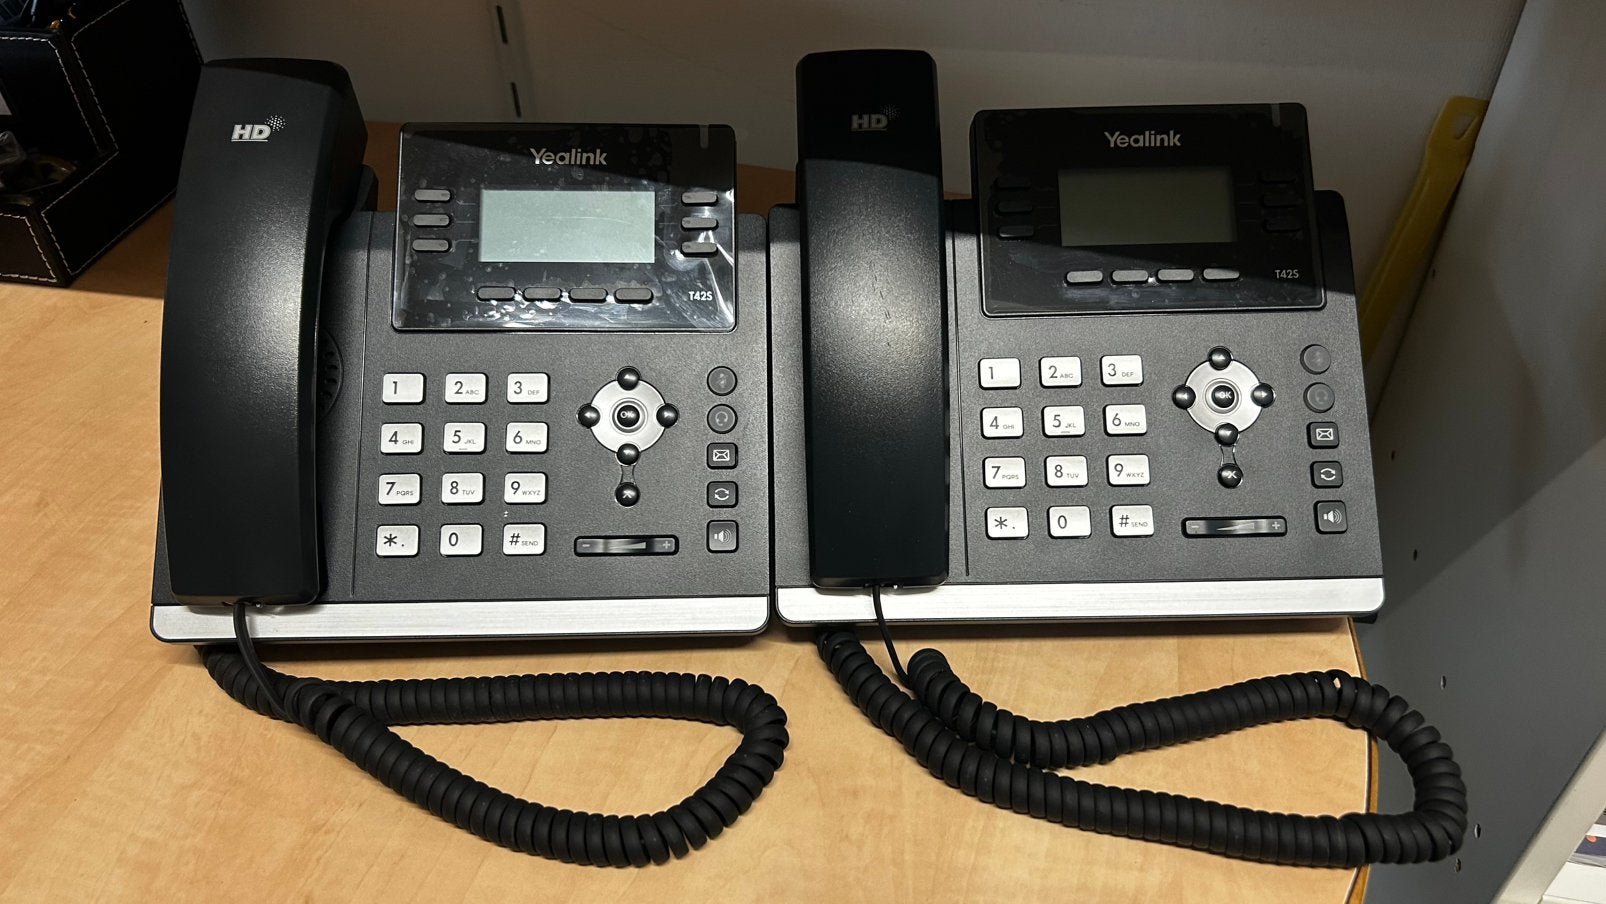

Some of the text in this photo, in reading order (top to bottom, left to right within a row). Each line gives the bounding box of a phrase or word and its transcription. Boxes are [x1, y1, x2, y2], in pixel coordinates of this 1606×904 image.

[851, 114, 888, 131] HD
[231, 124, 271, 142] HD
[1104, 130, 1182, 148] Yealink
[530, 148, 607, 166] Yealink
[1275, 269, 1299, 279] T42S
[688, 291, 712, 301] T42S
[988, 366, 994, 380] 1
[1048, 365, 1058, 378] 2
[1107, 363, 1117, 377] 3
[392, 380, 398, 395] 1
[454, 380, 464, 395] 2
[513, 380, 523, 395] 3
[989, 415, 1000, 430] 4
[1052, 414, 1061, 428] 5
[1112, 413, 1122, 427] 6
[388, 430, 399, 445] 4
[452, 430, 461, 443] 5
[512, 430, 523, 445] 6
[991, 466, 1001, 479] 7
[1054, 464, 1064, 478] 8
[1114, 463, 1124, 477] 9
[385, 481, 396, 496] 7
[450, 480, 459, 495] 8
[510, 480, 520, 495] 9
[1057, 515, 1068, 529] 0
[448, 532, 459, 546] 0
